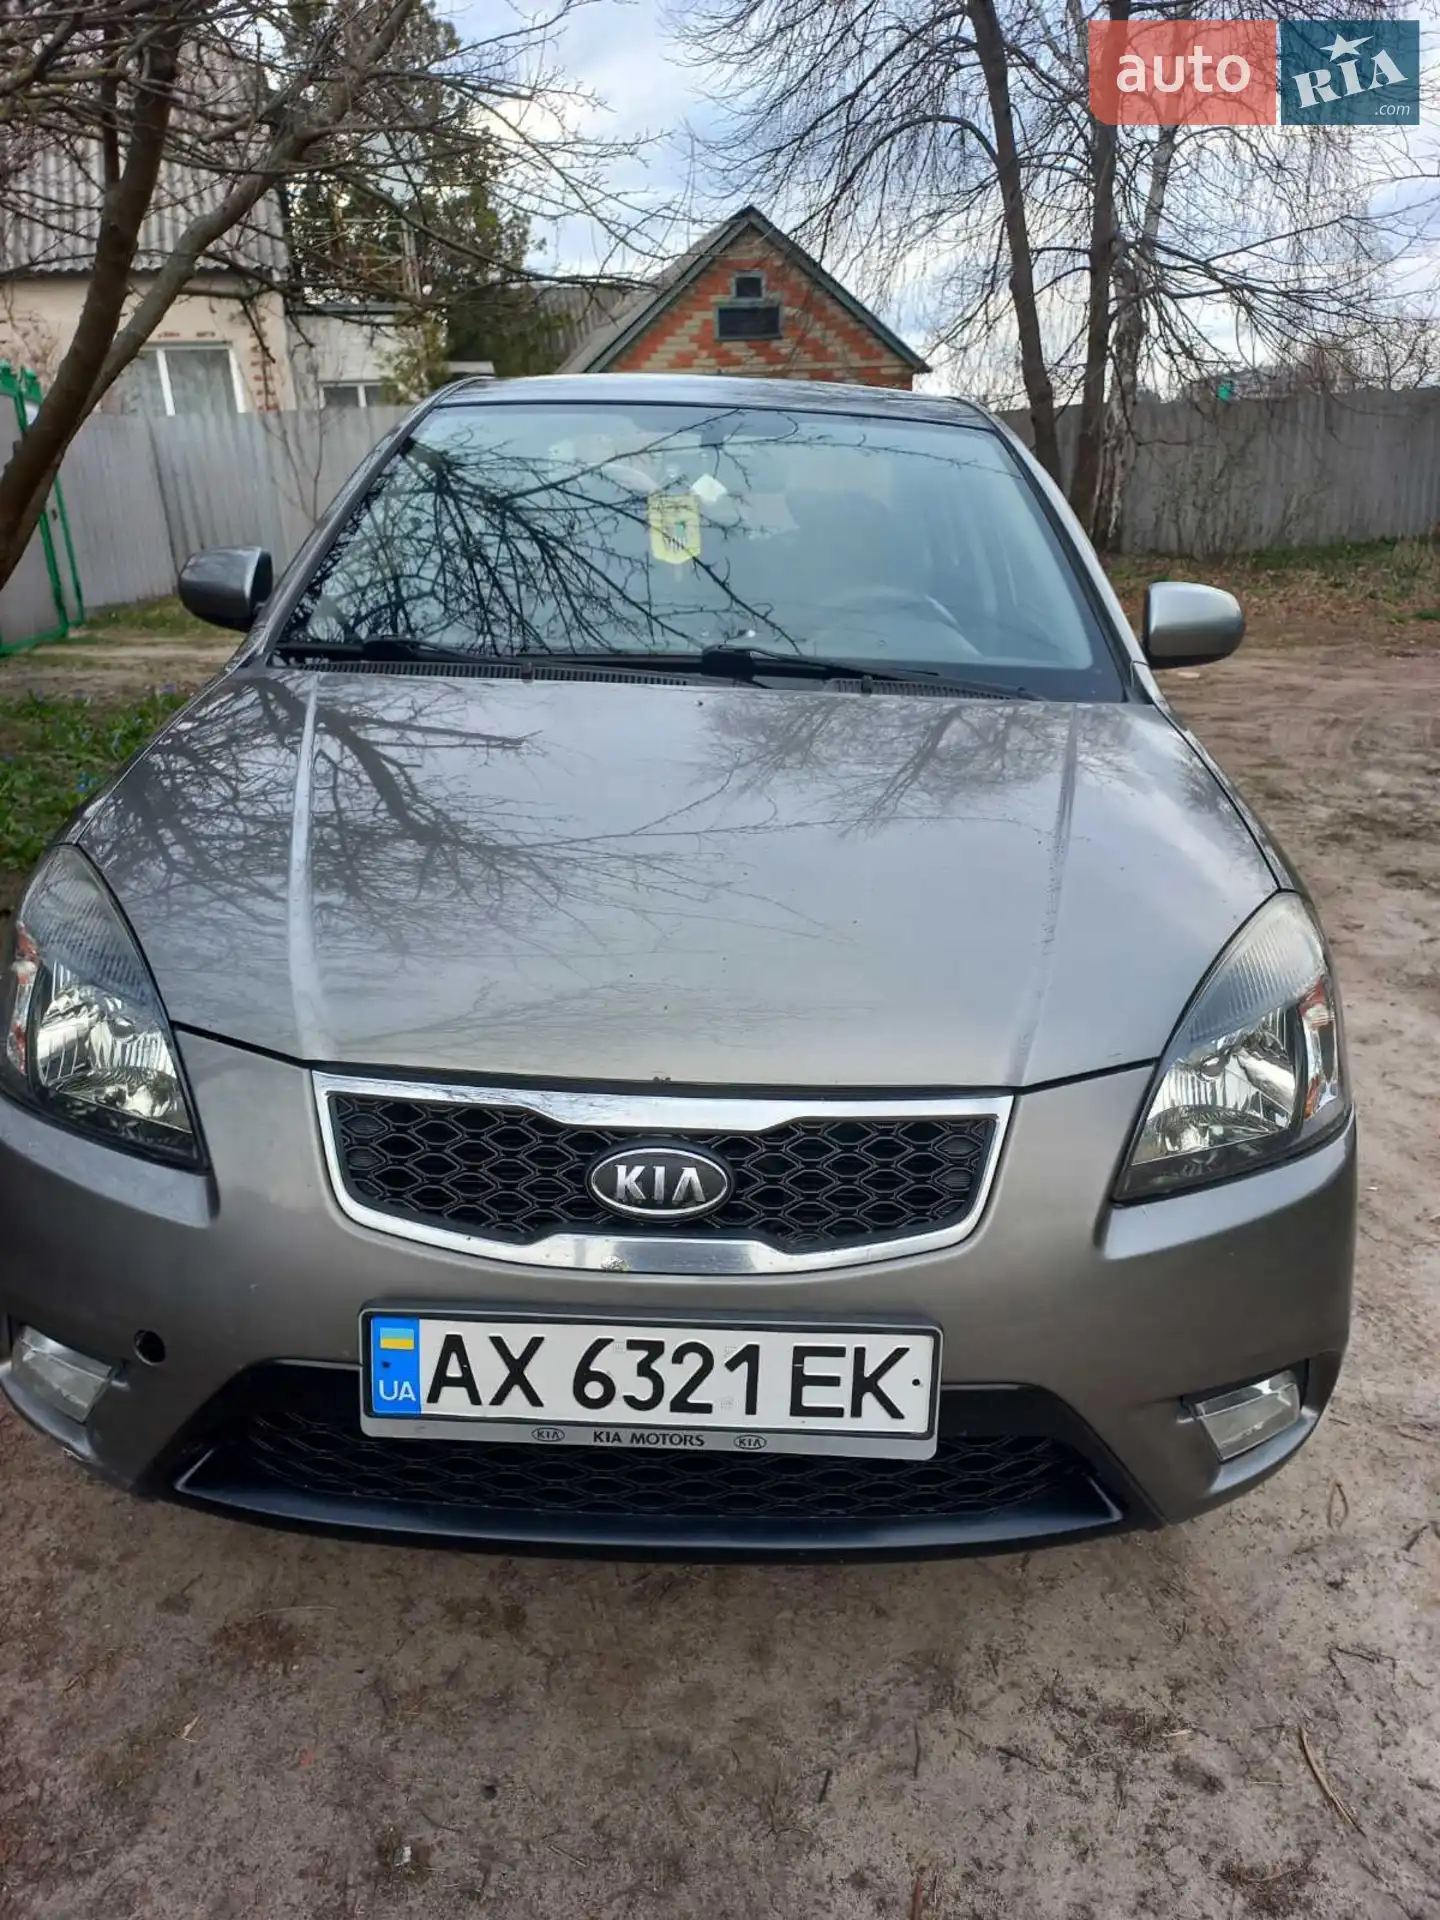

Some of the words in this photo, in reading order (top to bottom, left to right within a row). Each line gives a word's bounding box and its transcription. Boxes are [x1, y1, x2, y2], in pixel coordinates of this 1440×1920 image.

[614, 1164, 706, 1204] KIA
[378, 1379, 416, 1401] UA
[426, 1333, 546, 1408] AX
[572, 1336, 760, 1416] 6321
[789, 1345, 910, 1420] EK
[593, 1431, 622, 1444] KIA
[630, 1432, 705, 1447] MOTORS
